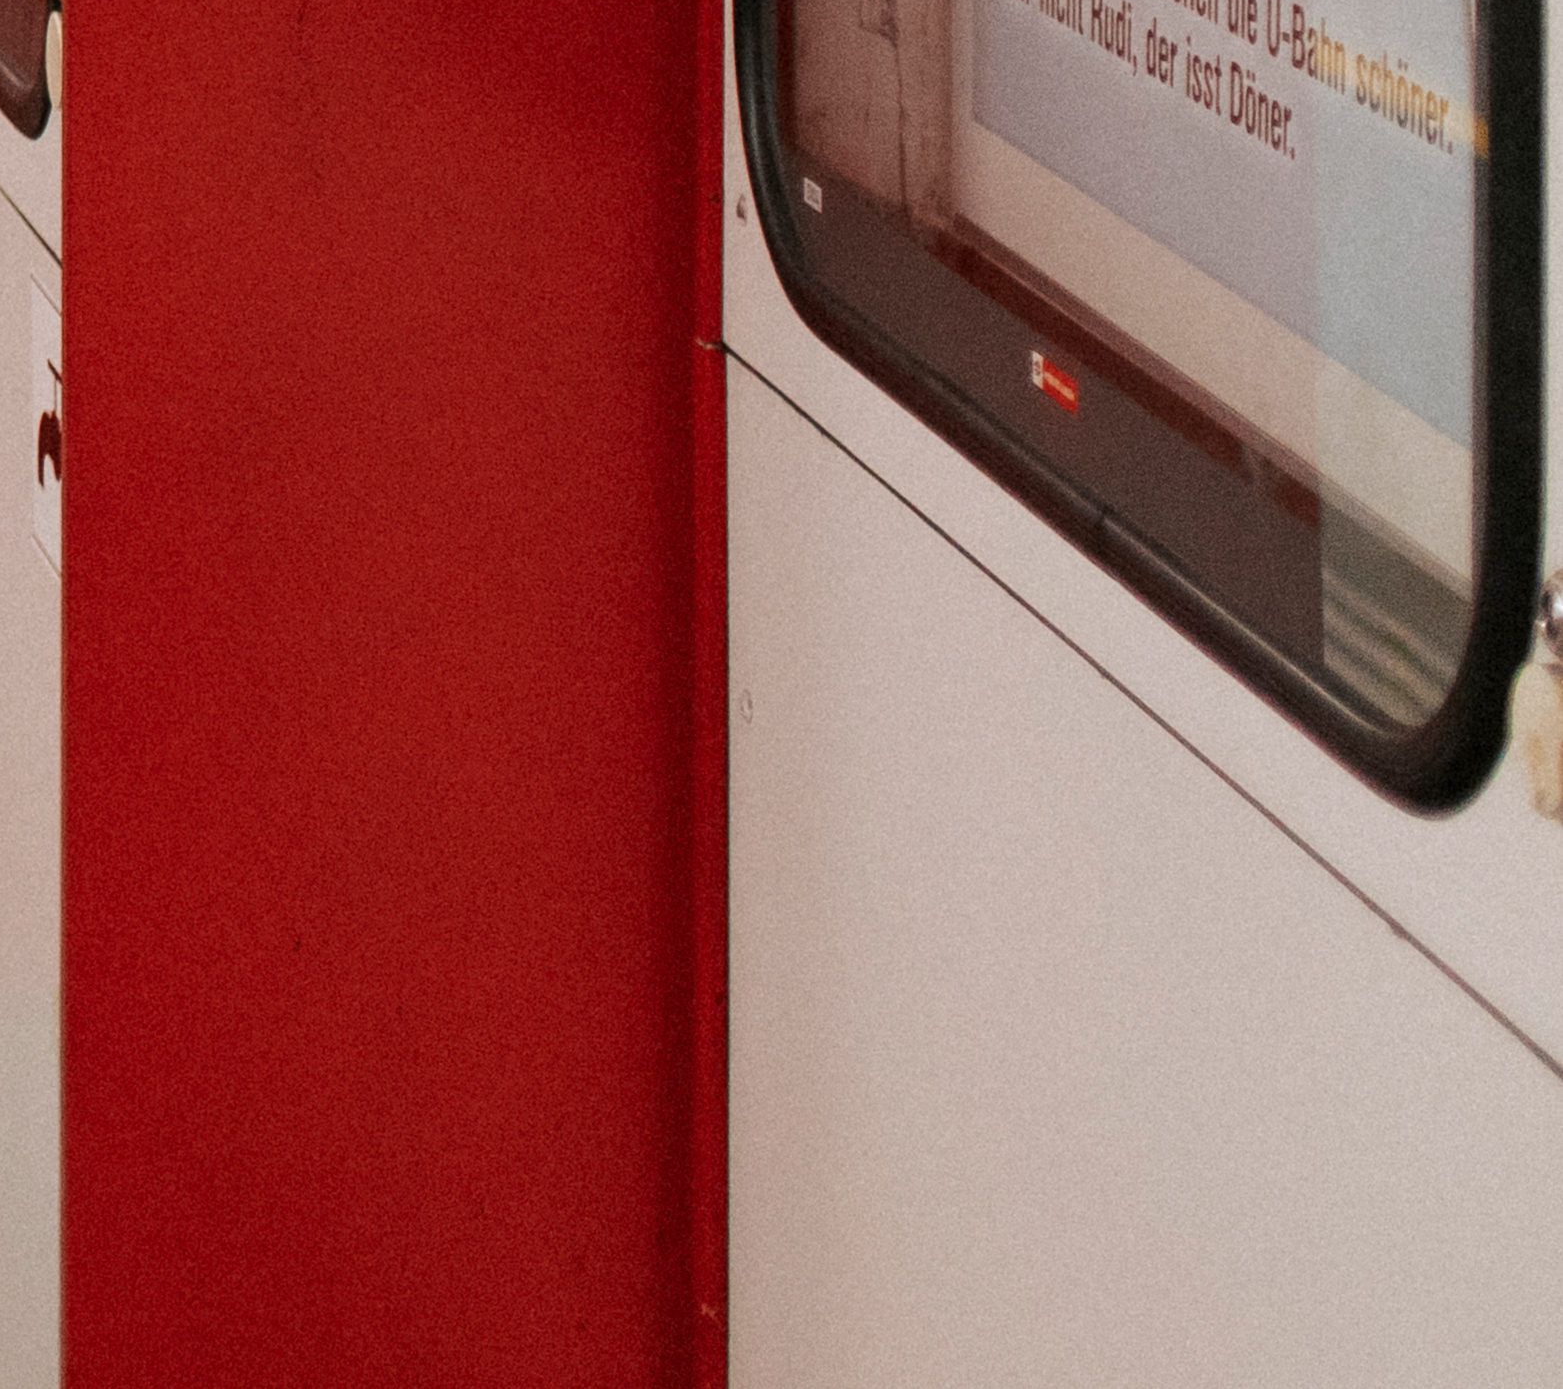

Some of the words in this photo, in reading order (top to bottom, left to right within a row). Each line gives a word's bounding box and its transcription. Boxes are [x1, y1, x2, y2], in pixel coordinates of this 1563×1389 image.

[1145, 17, 1178, 89] der
[1186, 35, 1222, 116] isst
[1229, 62, 1295, 160] Döner.
[1355, 50, 1453, 154] schöner.
